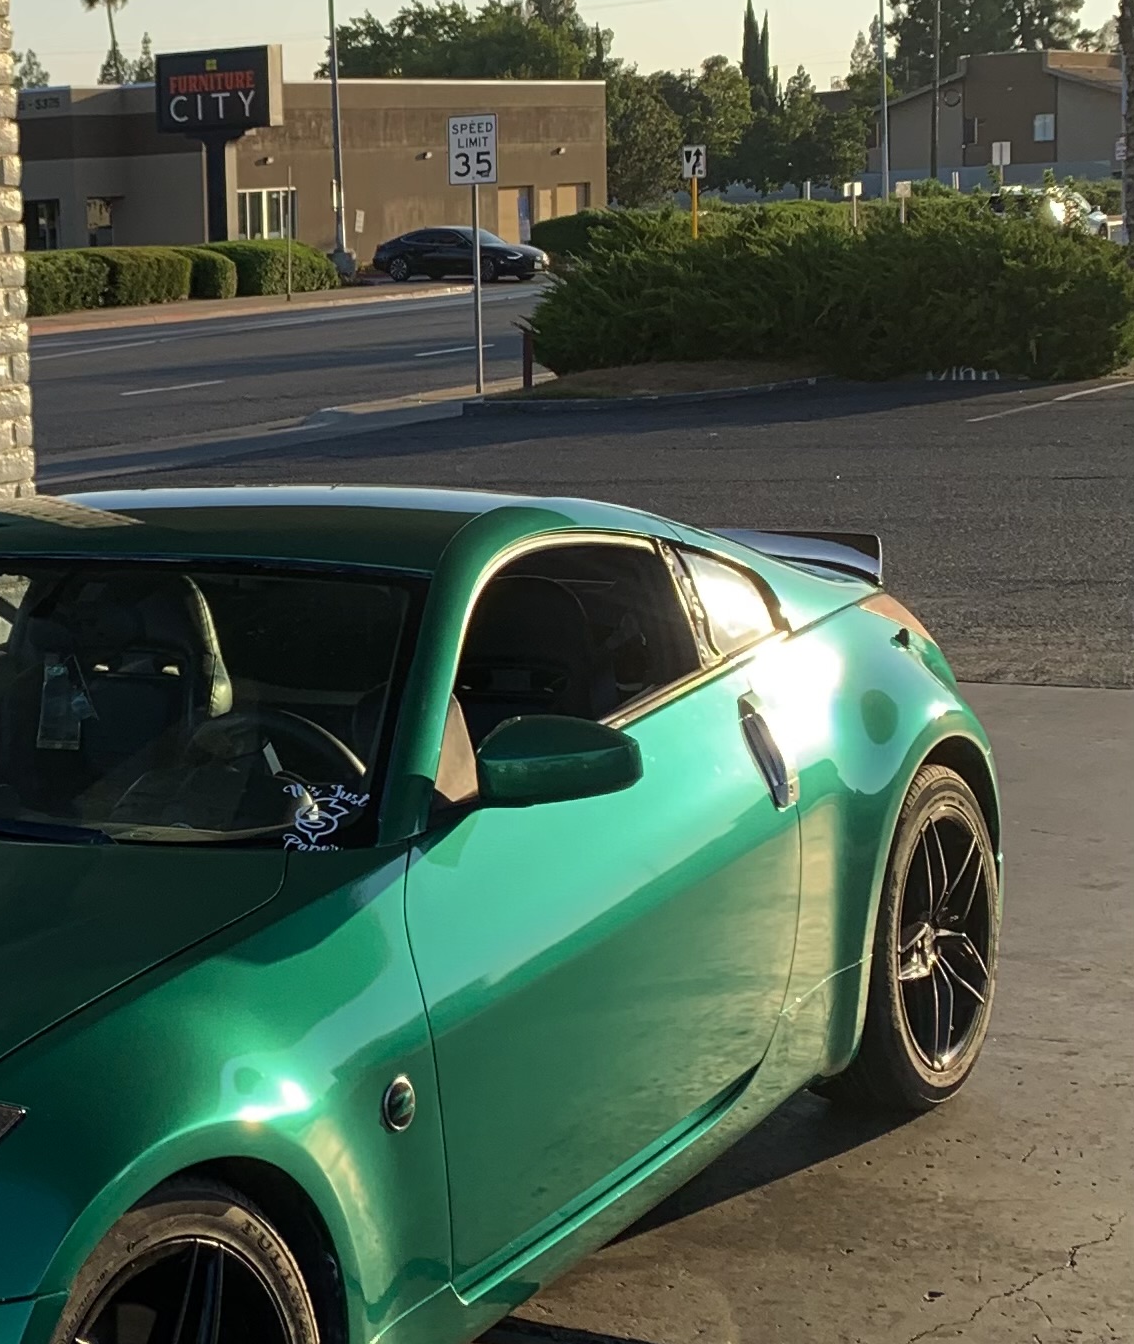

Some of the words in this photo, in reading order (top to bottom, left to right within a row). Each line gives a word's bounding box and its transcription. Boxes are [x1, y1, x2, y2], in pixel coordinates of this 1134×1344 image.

[169, 70, 256, 94] FURNITURE
[169, 90, 255, 123] CITY
[451, 122, 493, 135] SPEED
[457, 136, 489, 149] LIMIT
[454, 151, 492, 177] 35
[329, 784, 371, 808] Just
